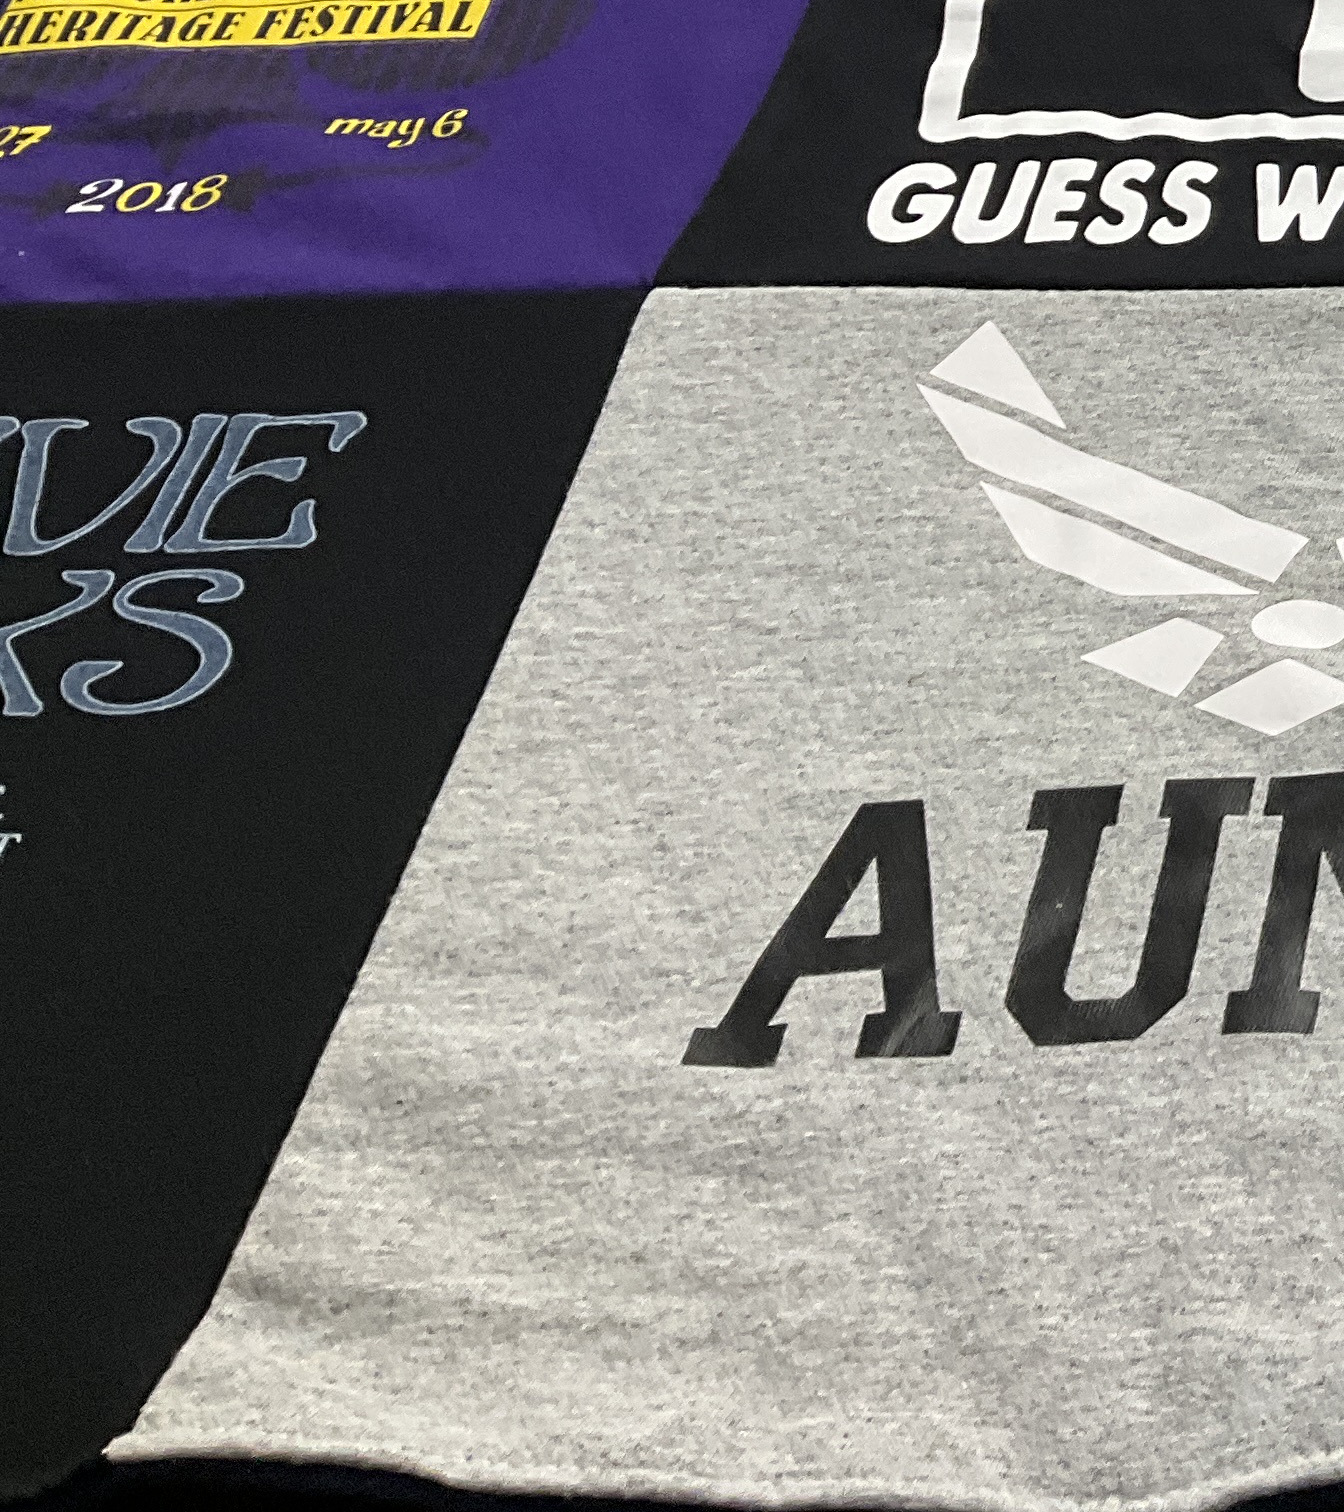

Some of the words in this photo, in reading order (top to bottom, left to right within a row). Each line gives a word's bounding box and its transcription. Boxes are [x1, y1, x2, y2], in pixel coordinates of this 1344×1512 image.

[0, 9, 246, 47] HERITAGE
[257, 0, 475, 40] FESTIVAL
[324, 117, 426, 150] may
[431, 108, 470, 139] 6
[65, 174, 229, 215] 2018
[866, 157, 1219, 245] GUESS
[0, 410, 368, 557] VIE
